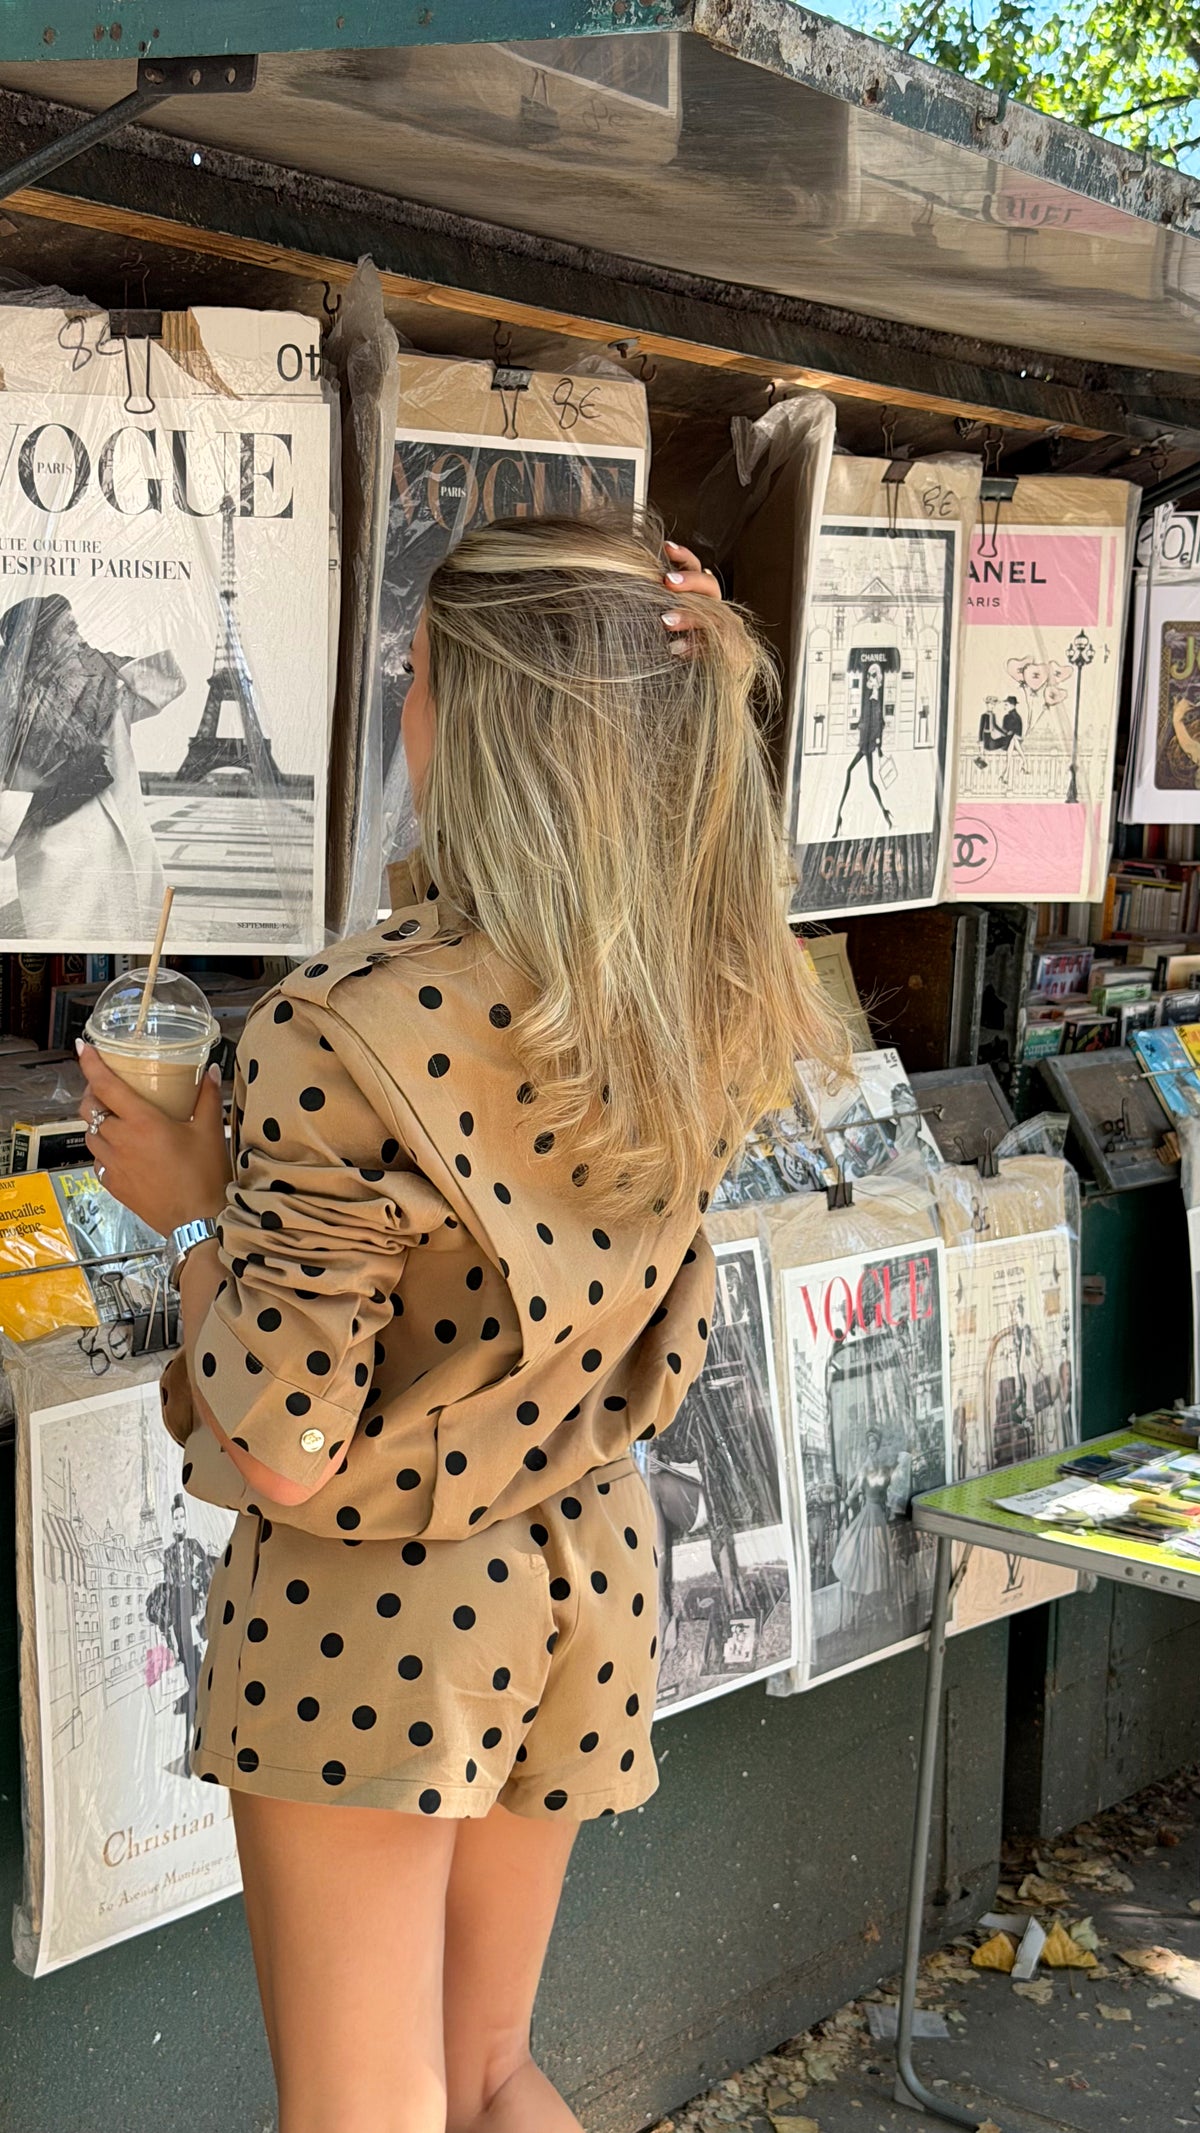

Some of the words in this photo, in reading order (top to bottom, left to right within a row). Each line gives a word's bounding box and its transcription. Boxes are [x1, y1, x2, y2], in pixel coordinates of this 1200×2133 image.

[553, 378, 600, 430] 8€
[0, 422, 294, 519] OGUE
[37, 462, 72, 474] PARIS
[441, 486, 466, 497] PARIS
[33, 539, 102, 553] COUTURE
[2, 556, 80, 576] ESPRIT
[91, 558, 192, 580] PARISIEN
[861, 653, 887, 663] CHANEL
[0, 1203, 46, 1221] ançailles
[800, 1257, 933, 1346] VOGUE
[103, 1812, 214, 1868] Christian
